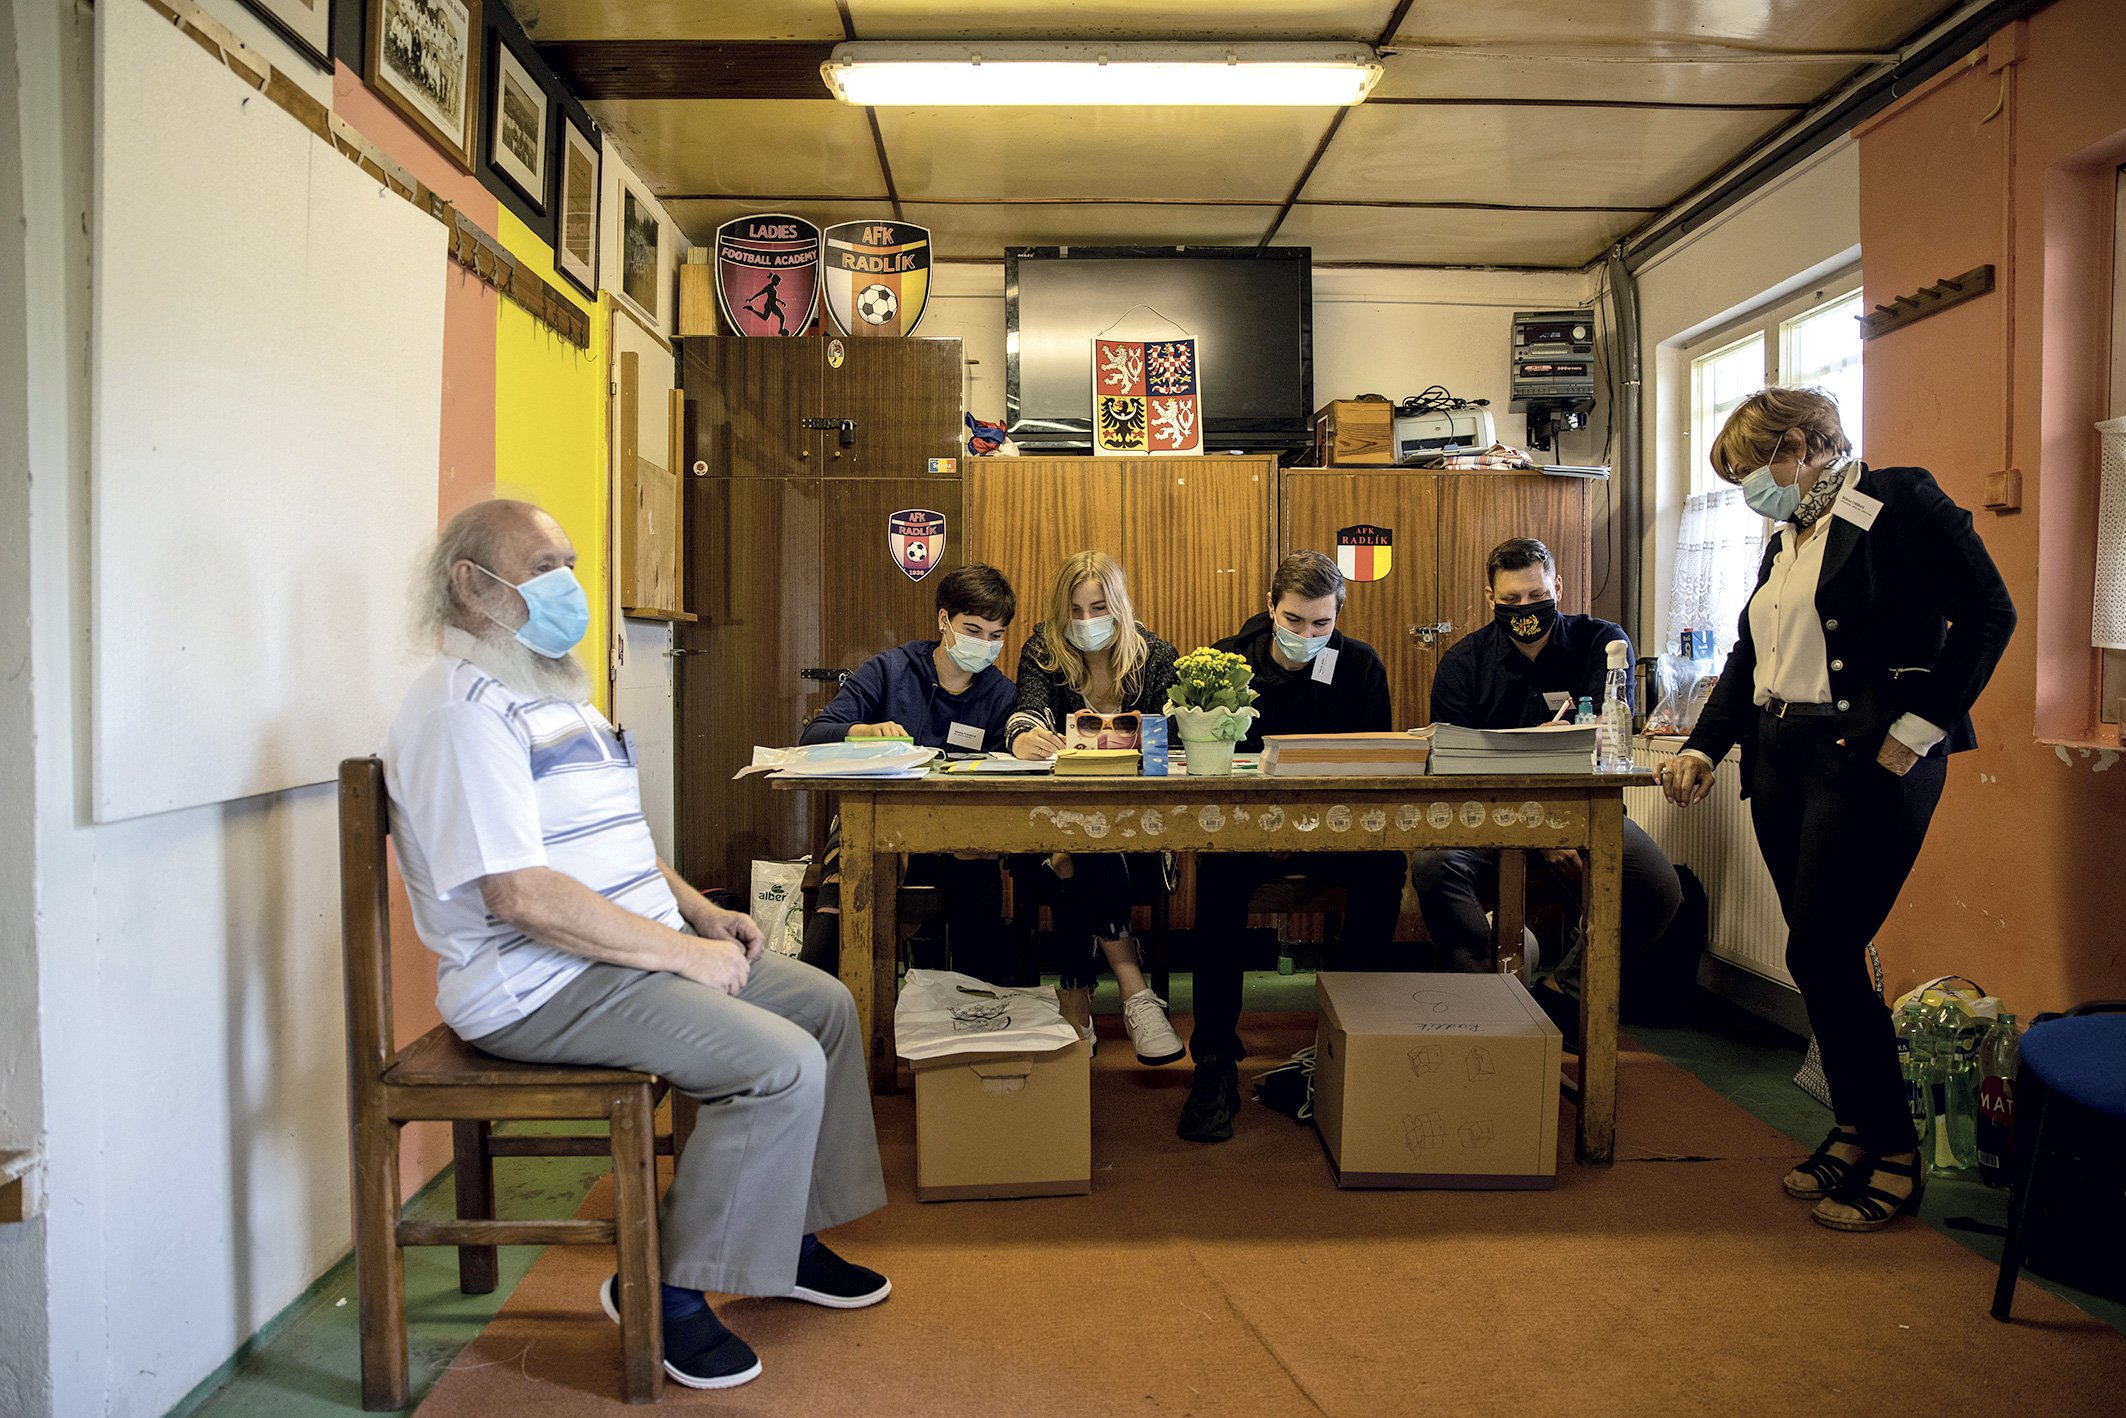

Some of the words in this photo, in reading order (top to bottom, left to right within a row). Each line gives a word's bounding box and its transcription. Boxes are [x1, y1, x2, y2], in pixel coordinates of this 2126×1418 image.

[749, 223, 798, 239] LADIES
[861, 226, 895, 246] AFK
[721, 247, 772, 266] FOOTBALL
[774, 250, 818, 266] ACADEMY
[841, 252, 916, 273] RADLÍK
[909, 512, 926, 522] AFK
[899, 526, 937, 535] RADLÍK
[1342, 534, 1388, 544] RADLÍK
[758, 891, 789, 902] alber
